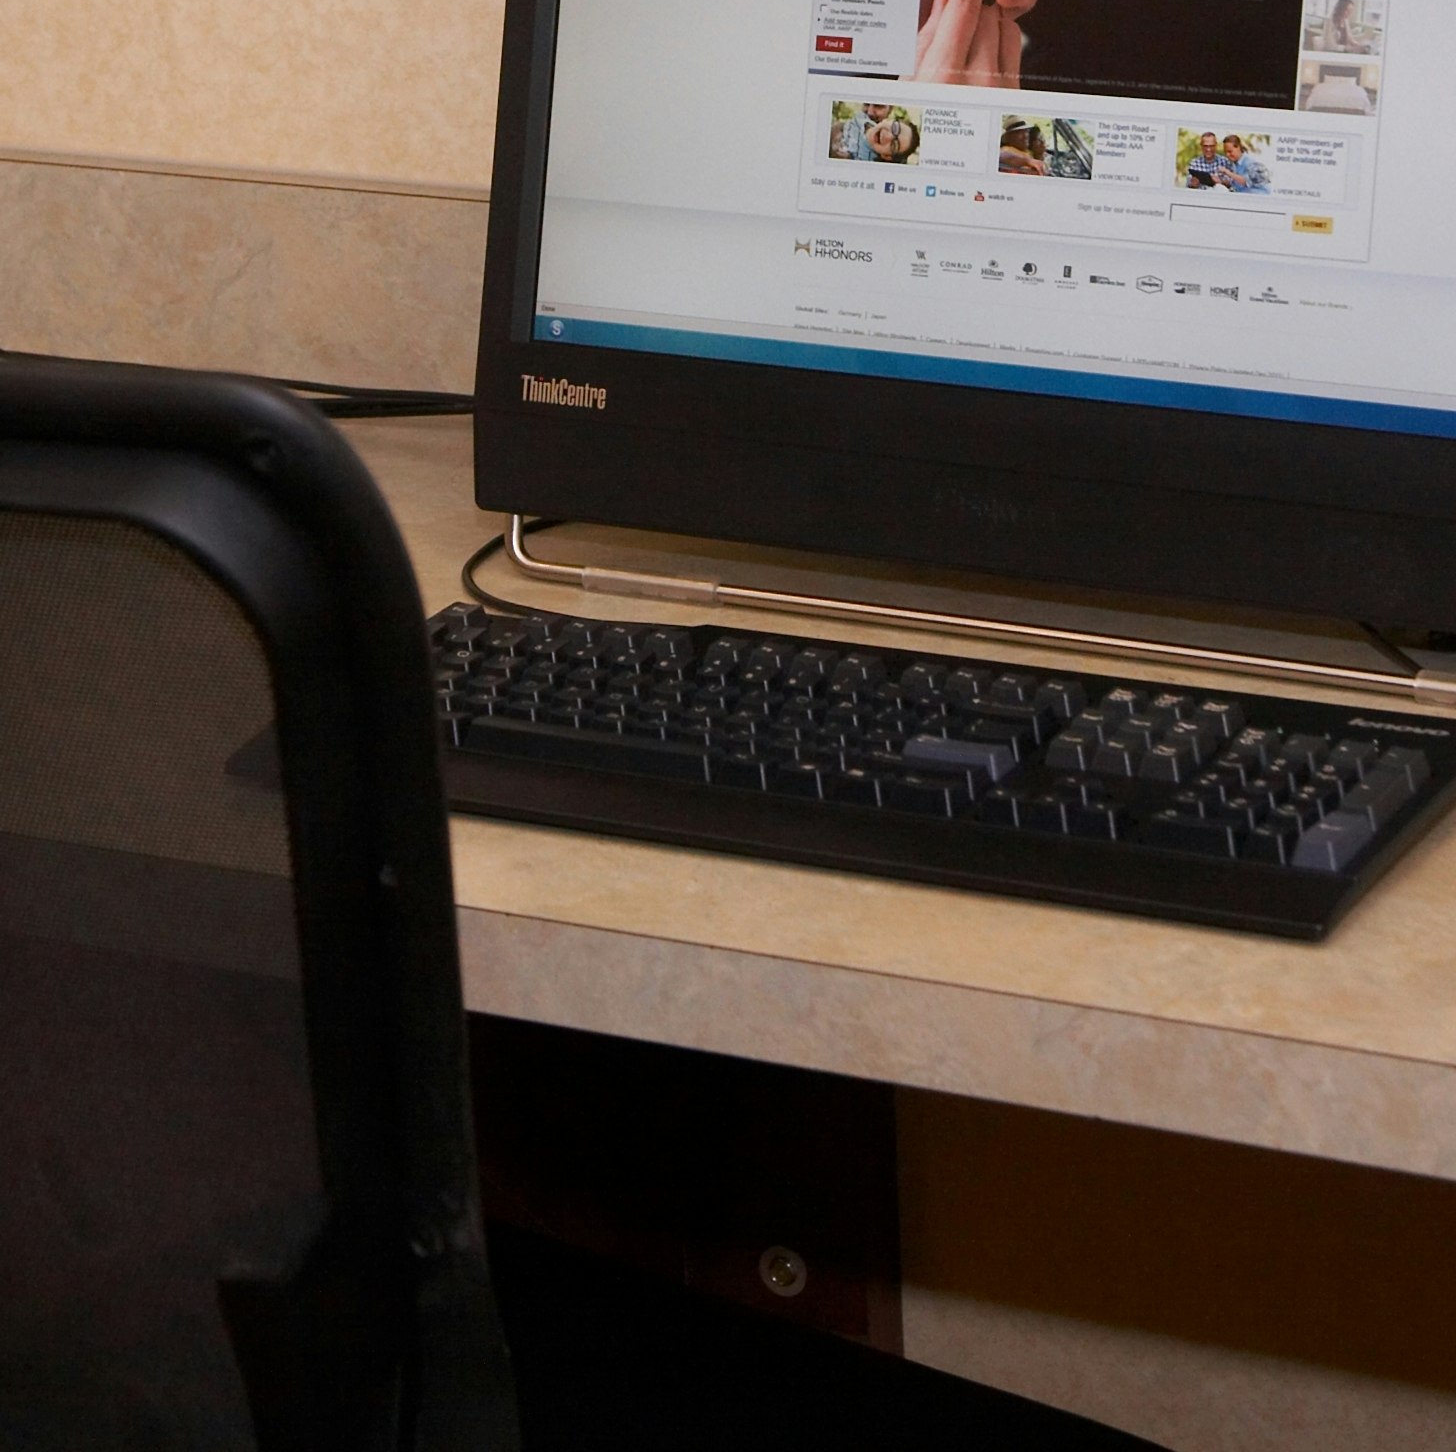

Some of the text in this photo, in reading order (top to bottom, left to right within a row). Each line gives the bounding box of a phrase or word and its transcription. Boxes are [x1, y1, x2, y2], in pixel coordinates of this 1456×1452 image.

[824, 39, 838, 48] Find
[826, 56, 839, 64] Best
[925, 108, 958, 118] ADVANCE
[924, 118, 961, 127] PURCHASE
[924, 126, 975, 136] PLAN FOR FUN
[1112, 123, 1130, 131] Open
[1131, 124, 1150, 133] Road
[1299, 139, 1331, 147] members
[1096, 149, 1126, 158] Members
[810, 177, 826, 187] stay
[838, 178, 849, 189] top
[815, 238, 844, 248] HILTON
[814, 248, 873, 263] HHONORS
[939, 261, 973, 270] CONRAD
[980, 267, 1004, 278] Hilton
[521, 374, 606, 410] ThinkCentre
